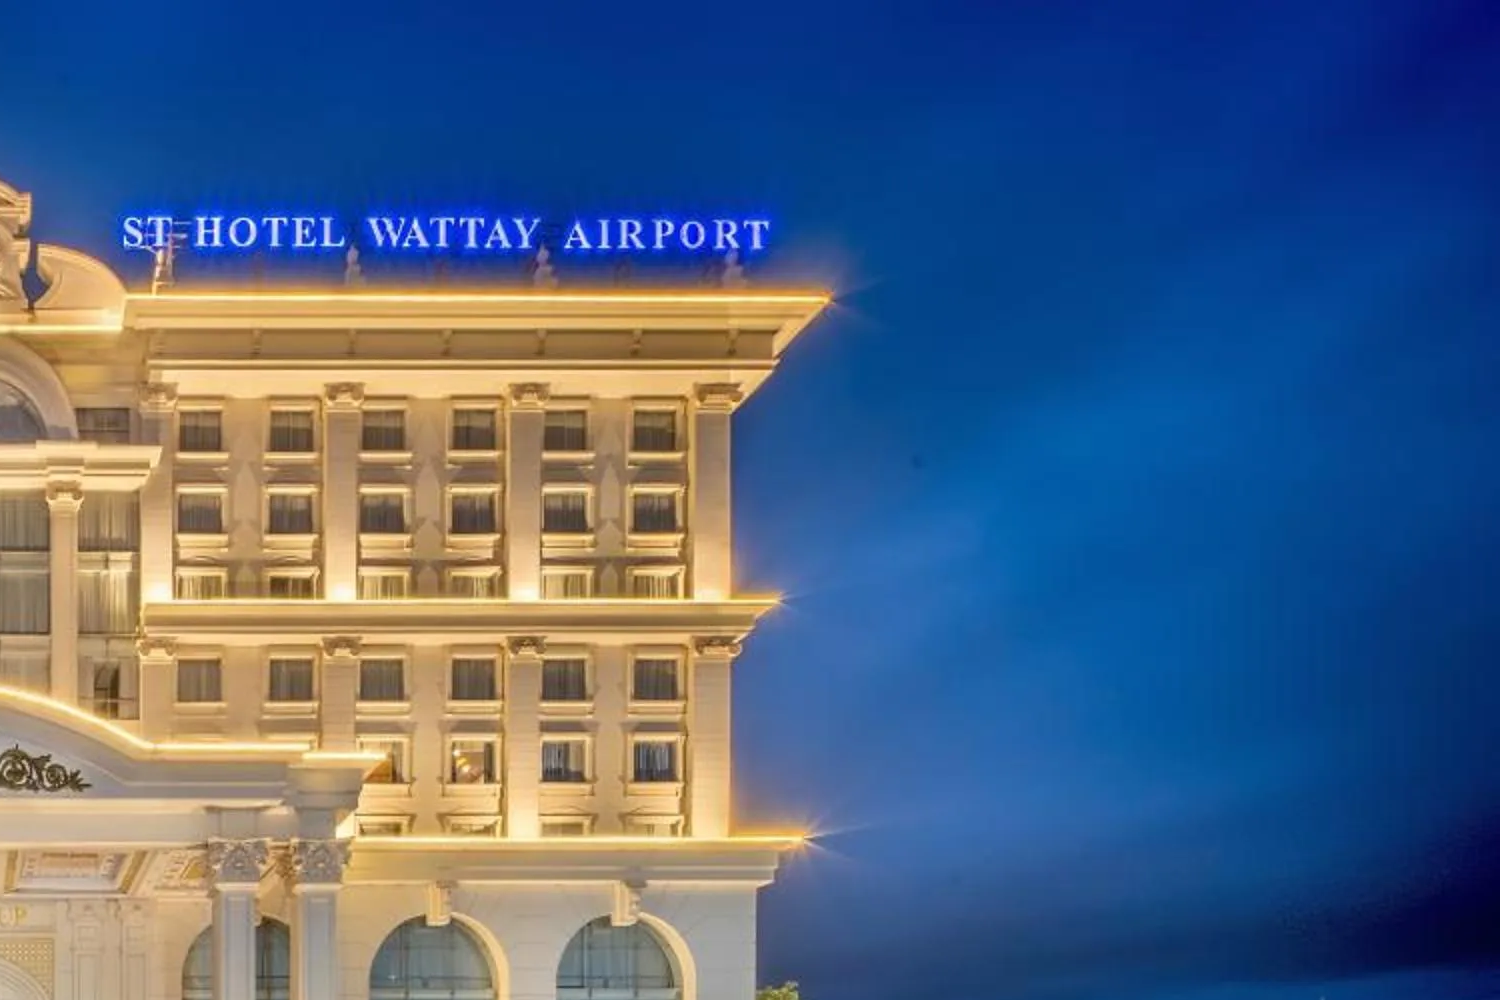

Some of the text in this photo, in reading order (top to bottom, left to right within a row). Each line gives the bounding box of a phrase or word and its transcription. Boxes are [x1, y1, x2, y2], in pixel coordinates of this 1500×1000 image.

[122, 216, 770, 250] ST HOTEL WATTAY AIRPORT
